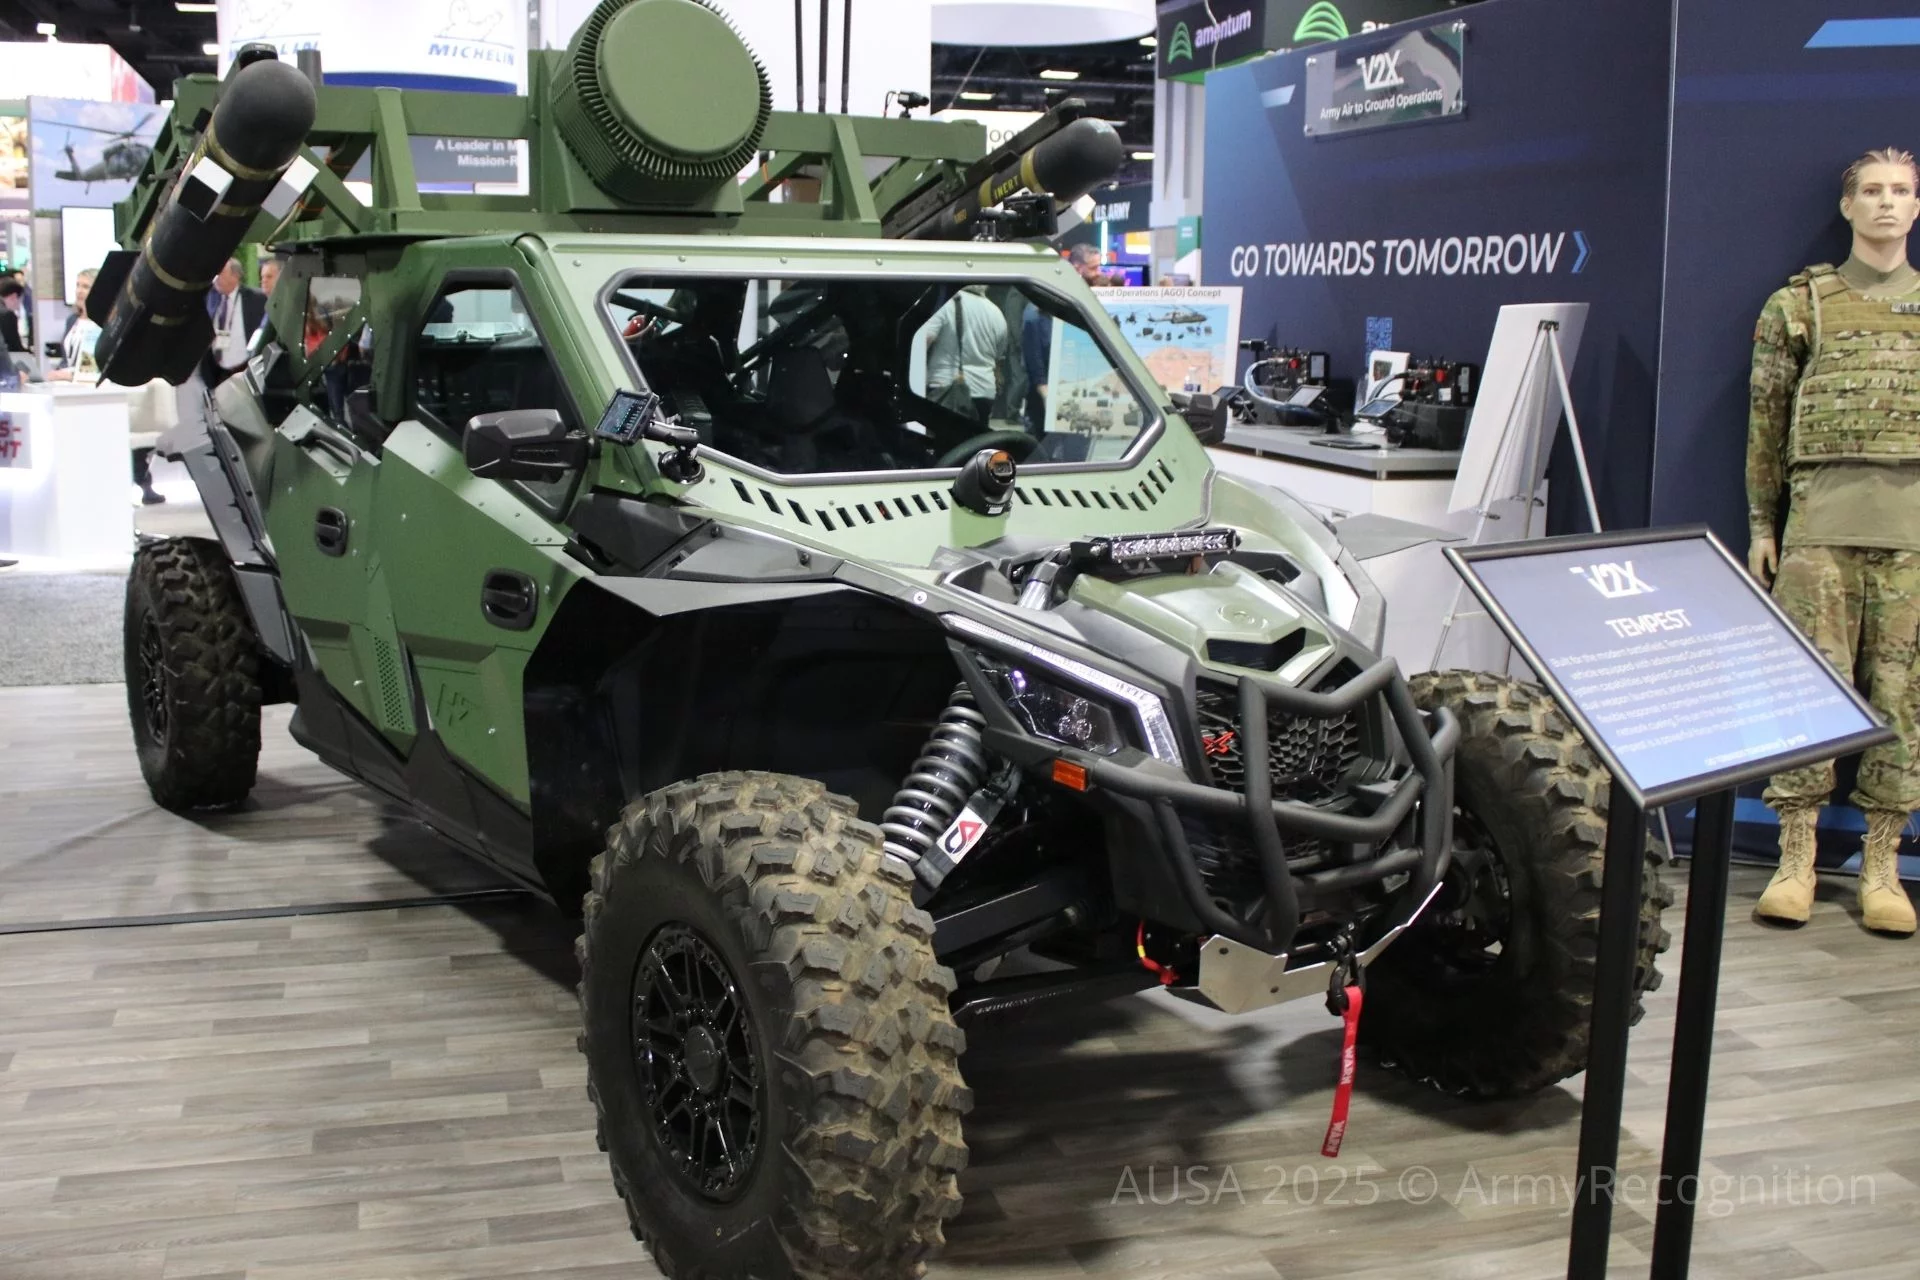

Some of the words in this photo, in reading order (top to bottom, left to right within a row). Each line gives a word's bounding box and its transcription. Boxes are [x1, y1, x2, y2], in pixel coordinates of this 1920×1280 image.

[1195, 10, 1251, 47] amentum
[428, 43, 514, 65] MICHELIN
[1356, 49, 1404, 91] V2X
[1320, 107, 1341, 121] Army
[1342, 105, 1354, 116] Air
[1355, 103, 1363, 114] to
[1364, 95, 1396, 112] Ground
[1396, 88, 1443, 109] Operations
[434, 139, 445, 151] A
[447, 139, 489, 151] Leader
[492, 139, 504, 151] in
[457, 155, 518, 166] Mission-R
[994, 175, 1019, 200] INERT
[1109, 201, 1130, 220] ARMY
[1230, 245, 1259, 277] GO
[1264, 241, 1377, 277] TOWARDS
[1382, 232, 1566, 276] TOMORROW
[1117, 288, 1158, 298] Operations
[1160, 288, 1185, 298] (AGO)
[1187, 288, 1221, 298] Concept
[1604, 609, 1692, 638] TEMPEST
